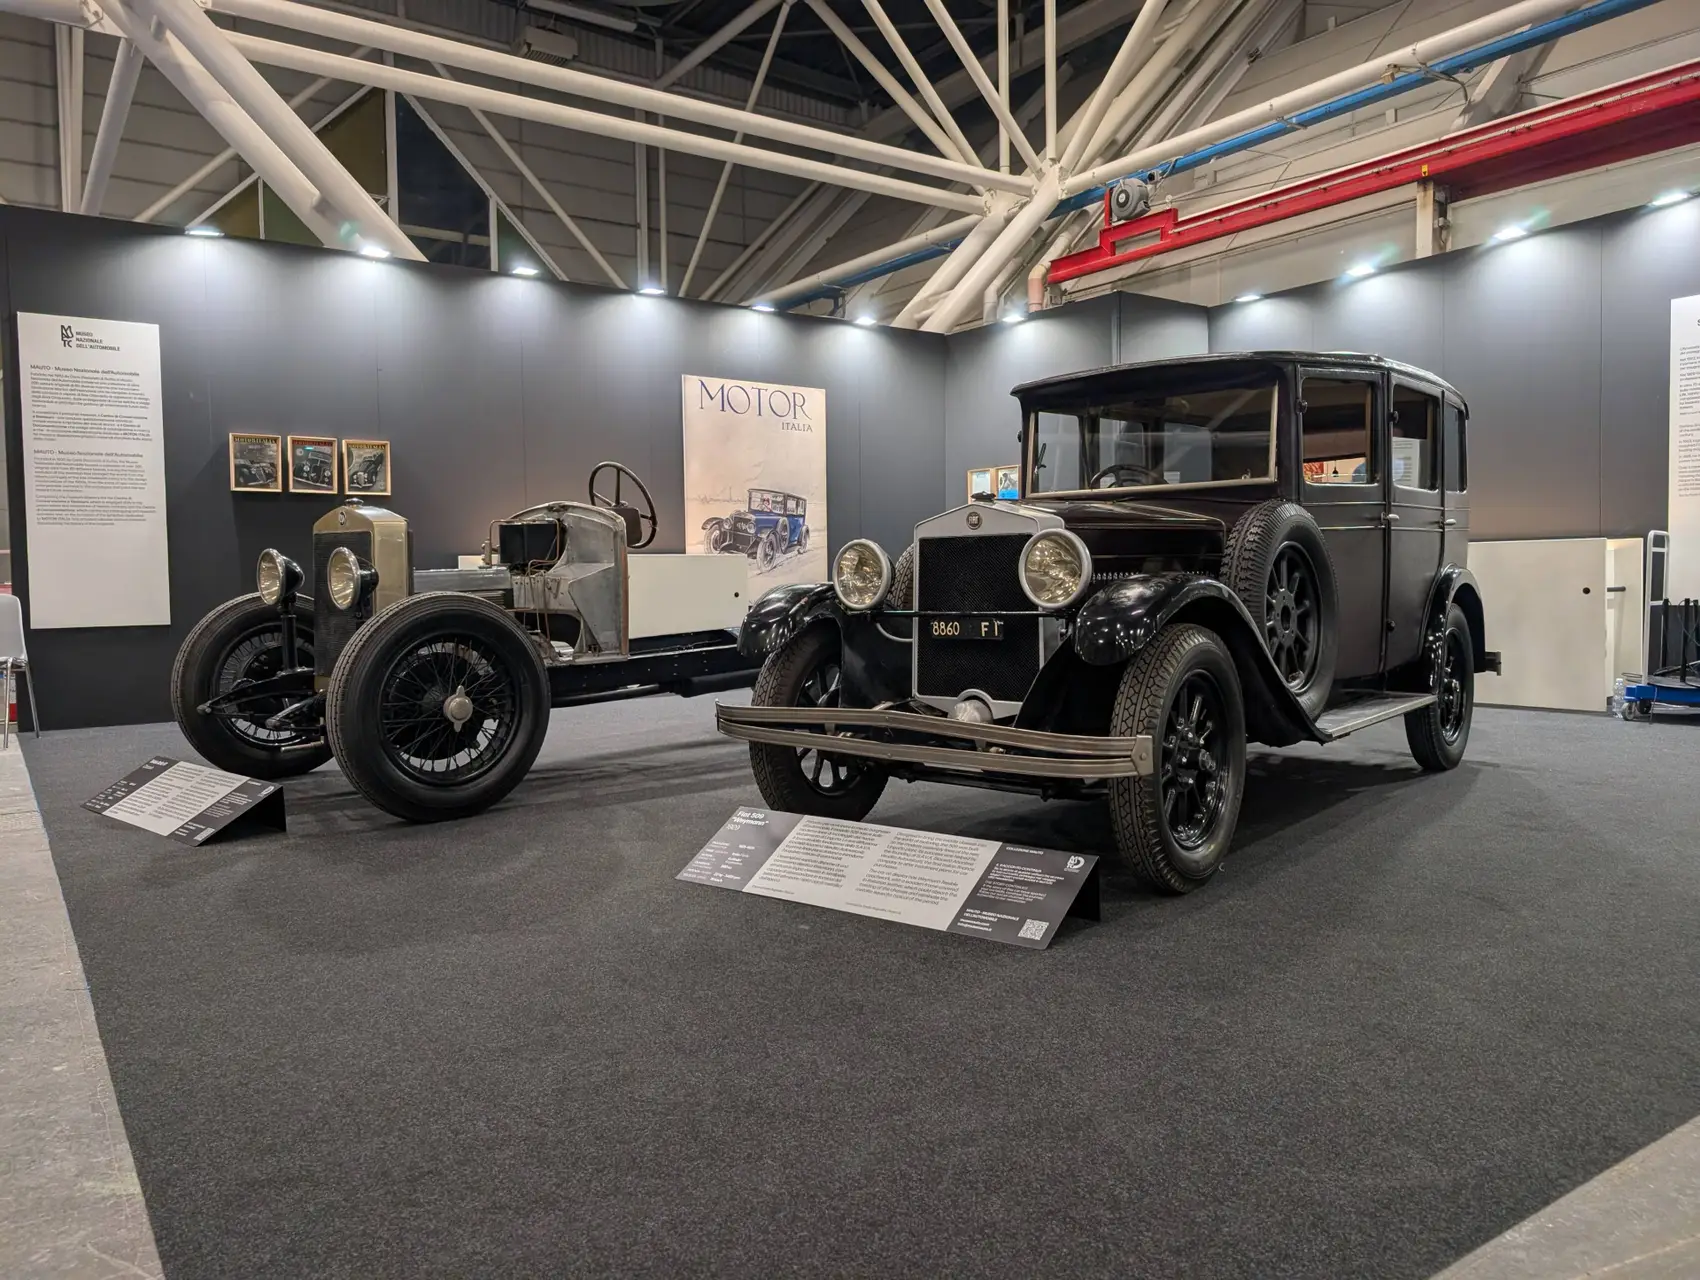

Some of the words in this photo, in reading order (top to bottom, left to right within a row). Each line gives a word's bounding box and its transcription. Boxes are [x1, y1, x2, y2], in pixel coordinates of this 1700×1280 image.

[76, 343, 120, 351] DELL'AUTOMOBILE
[698, 379, 812, 420] MOTOR
[781, 421, 813, 433] ITALIA
[932, 621, 960, 636] 8860
